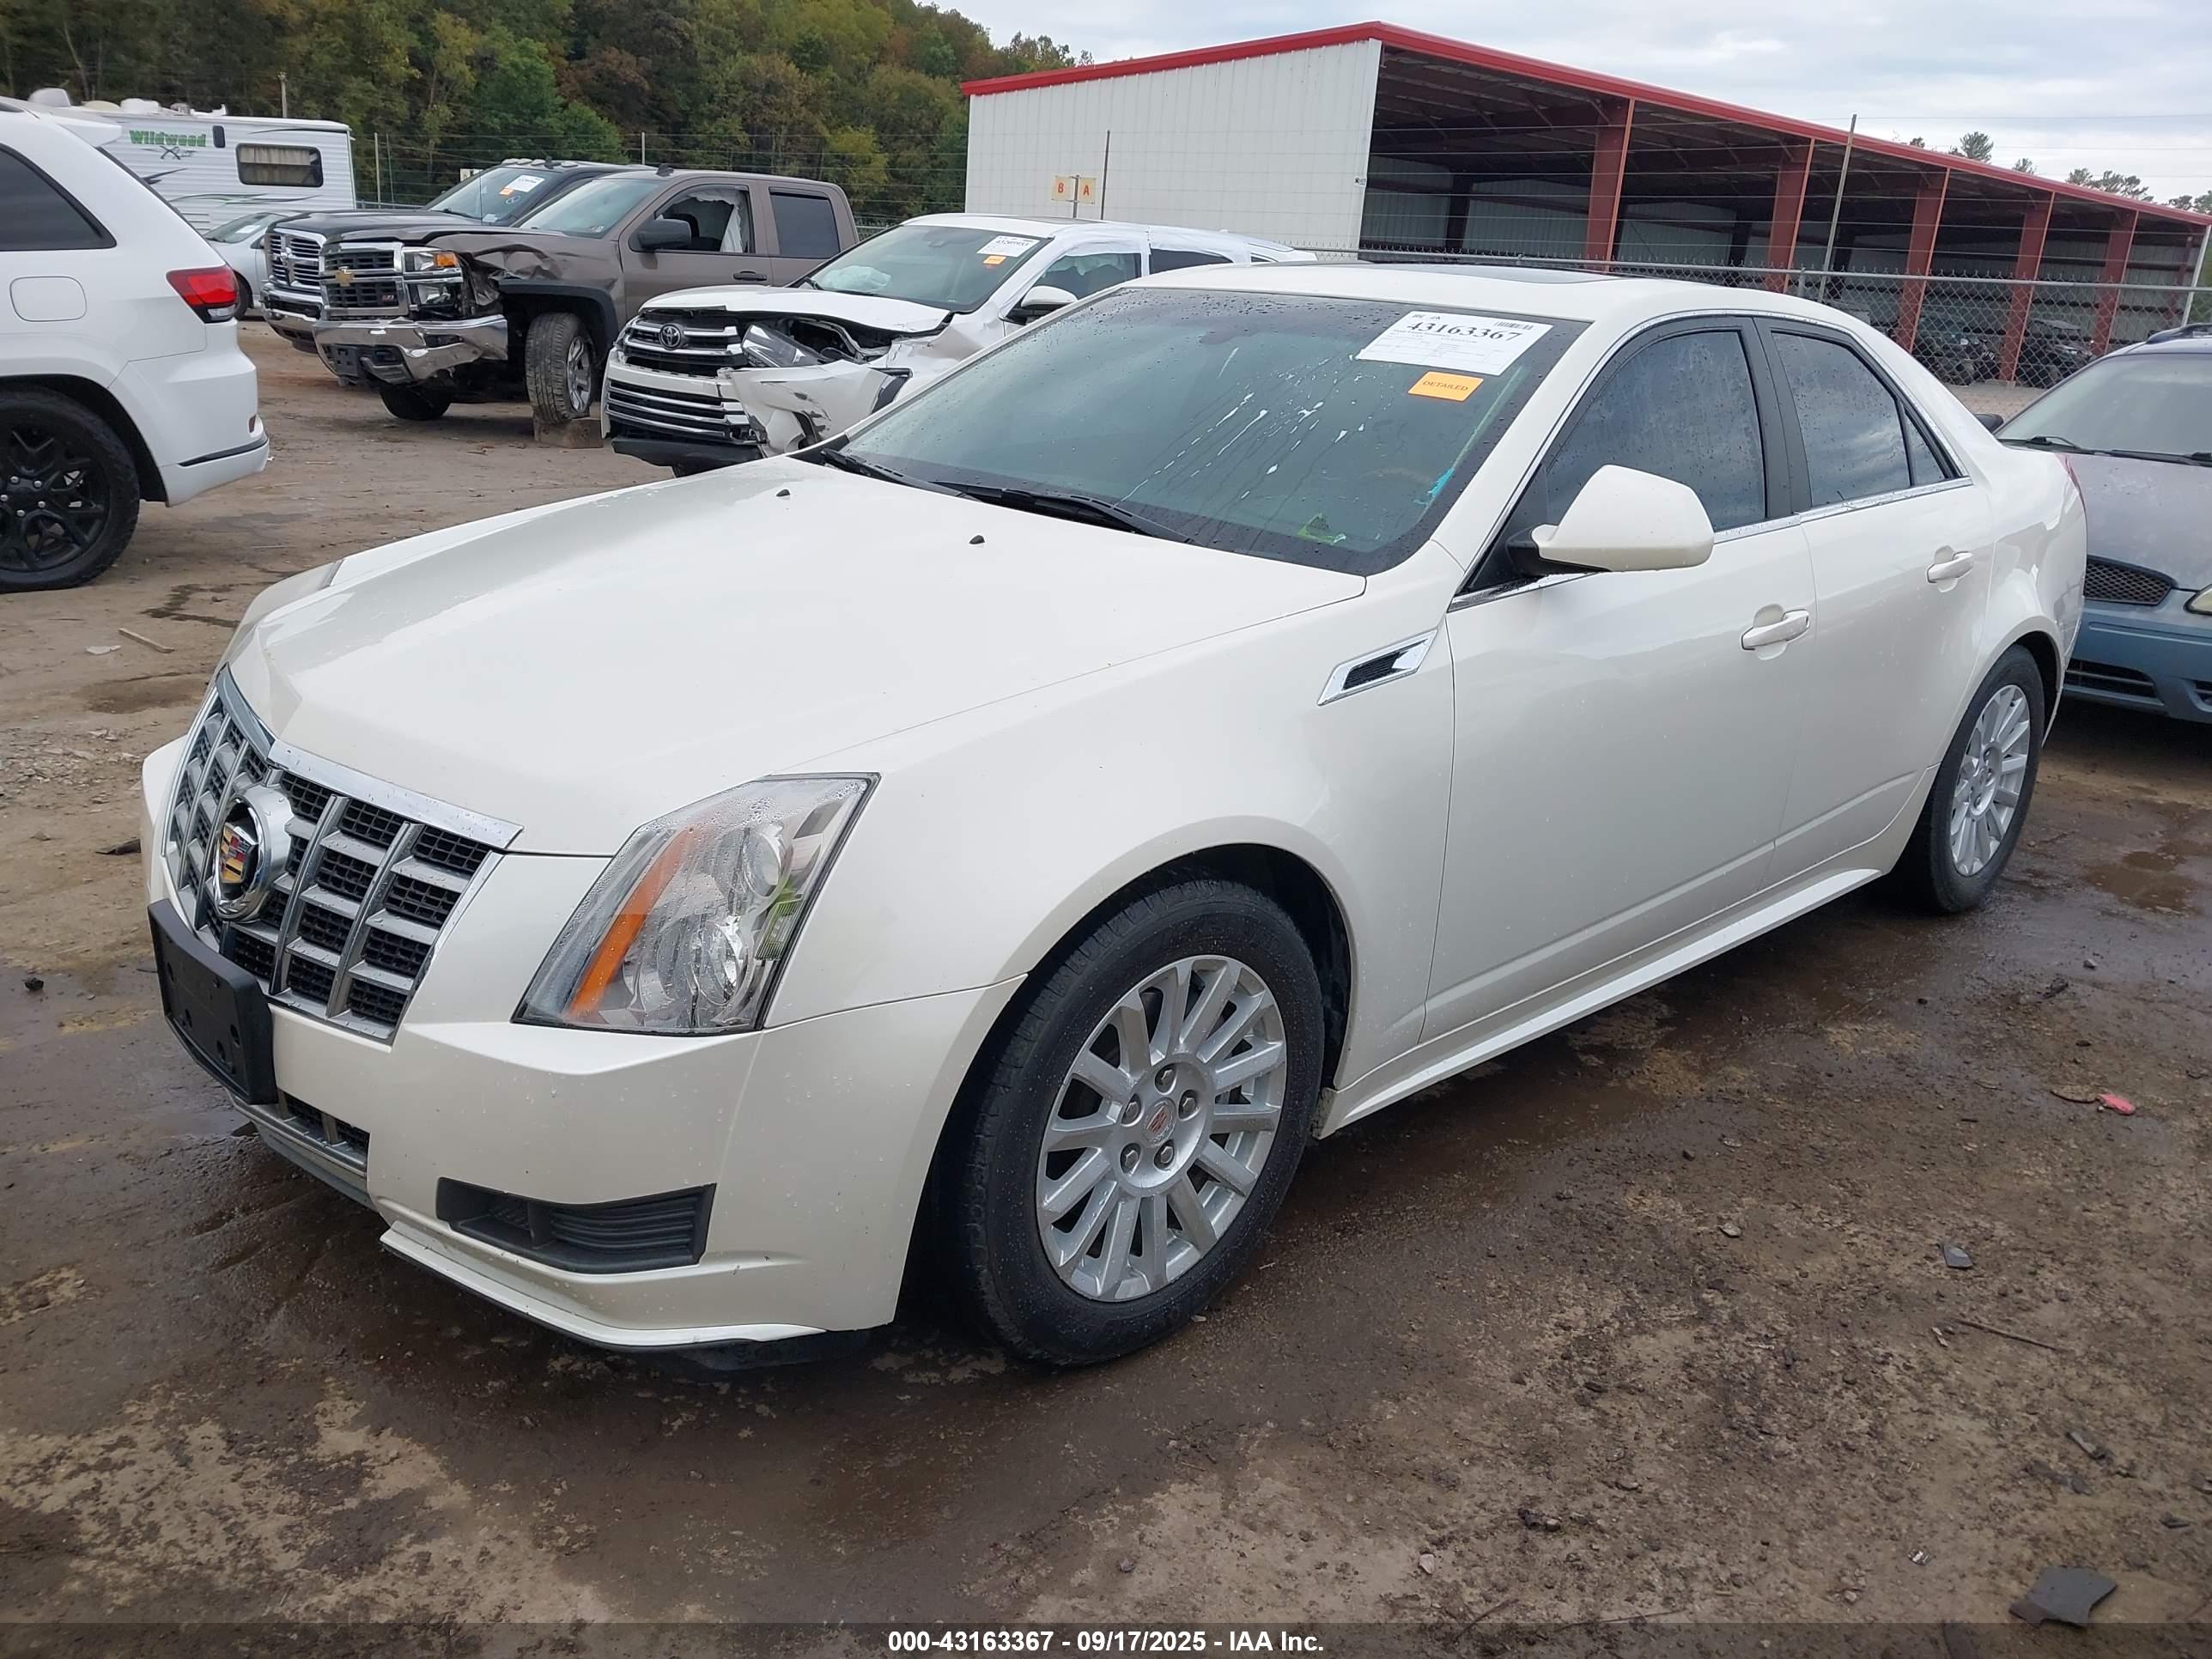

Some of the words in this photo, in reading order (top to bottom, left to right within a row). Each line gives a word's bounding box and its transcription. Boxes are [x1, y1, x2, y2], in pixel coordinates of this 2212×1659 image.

[129, 130, 206, 147] Wildwood
[1057, 182, 1065, 193] B
[1083, 185, 1090, 196] A
[1407, 321, 1523, 342] 43163367
[1422, 380, 1469, 392] DETAILED
